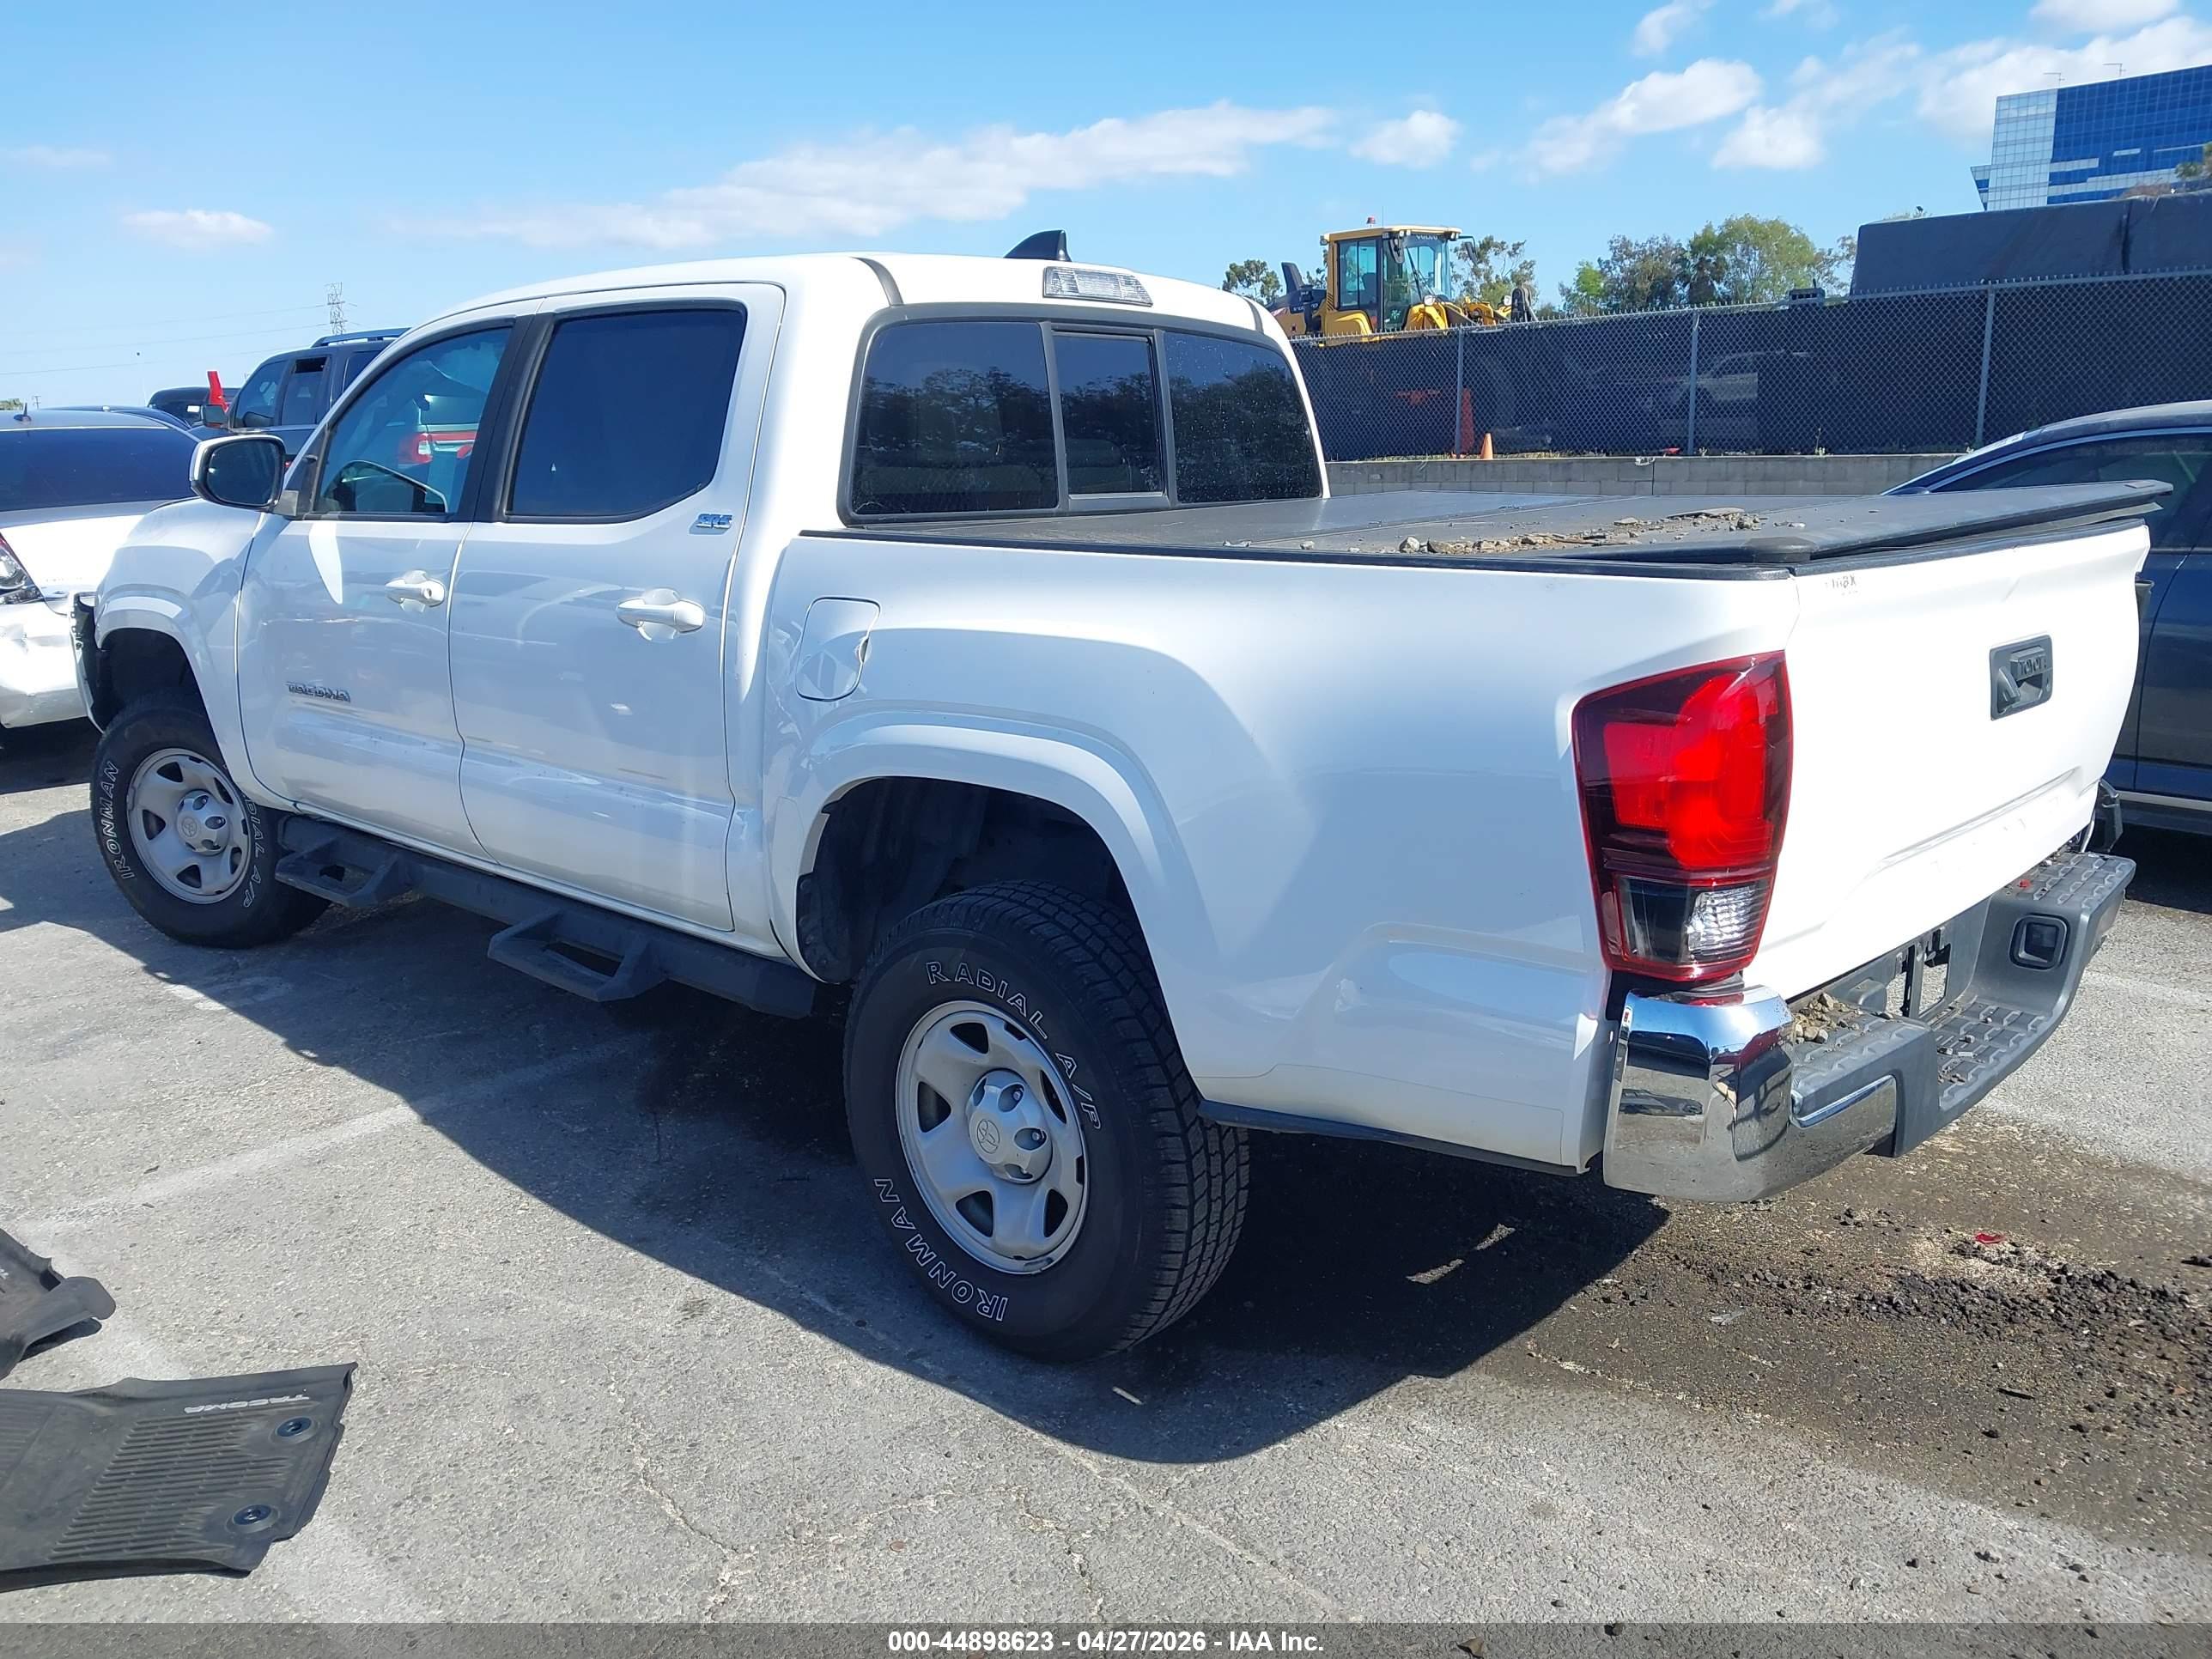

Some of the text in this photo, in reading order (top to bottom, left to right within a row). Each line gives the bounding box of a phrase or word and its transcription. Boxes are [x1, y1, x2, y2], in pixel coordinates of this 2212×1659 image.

[100, 761, 135, 879] IRONMAN
[243, 798, 265, 908] DIAL A/P
[926, 961, 1103, 1131] RADIAL A/P
[873, 1176, 1009, 1322] IRONMAN
